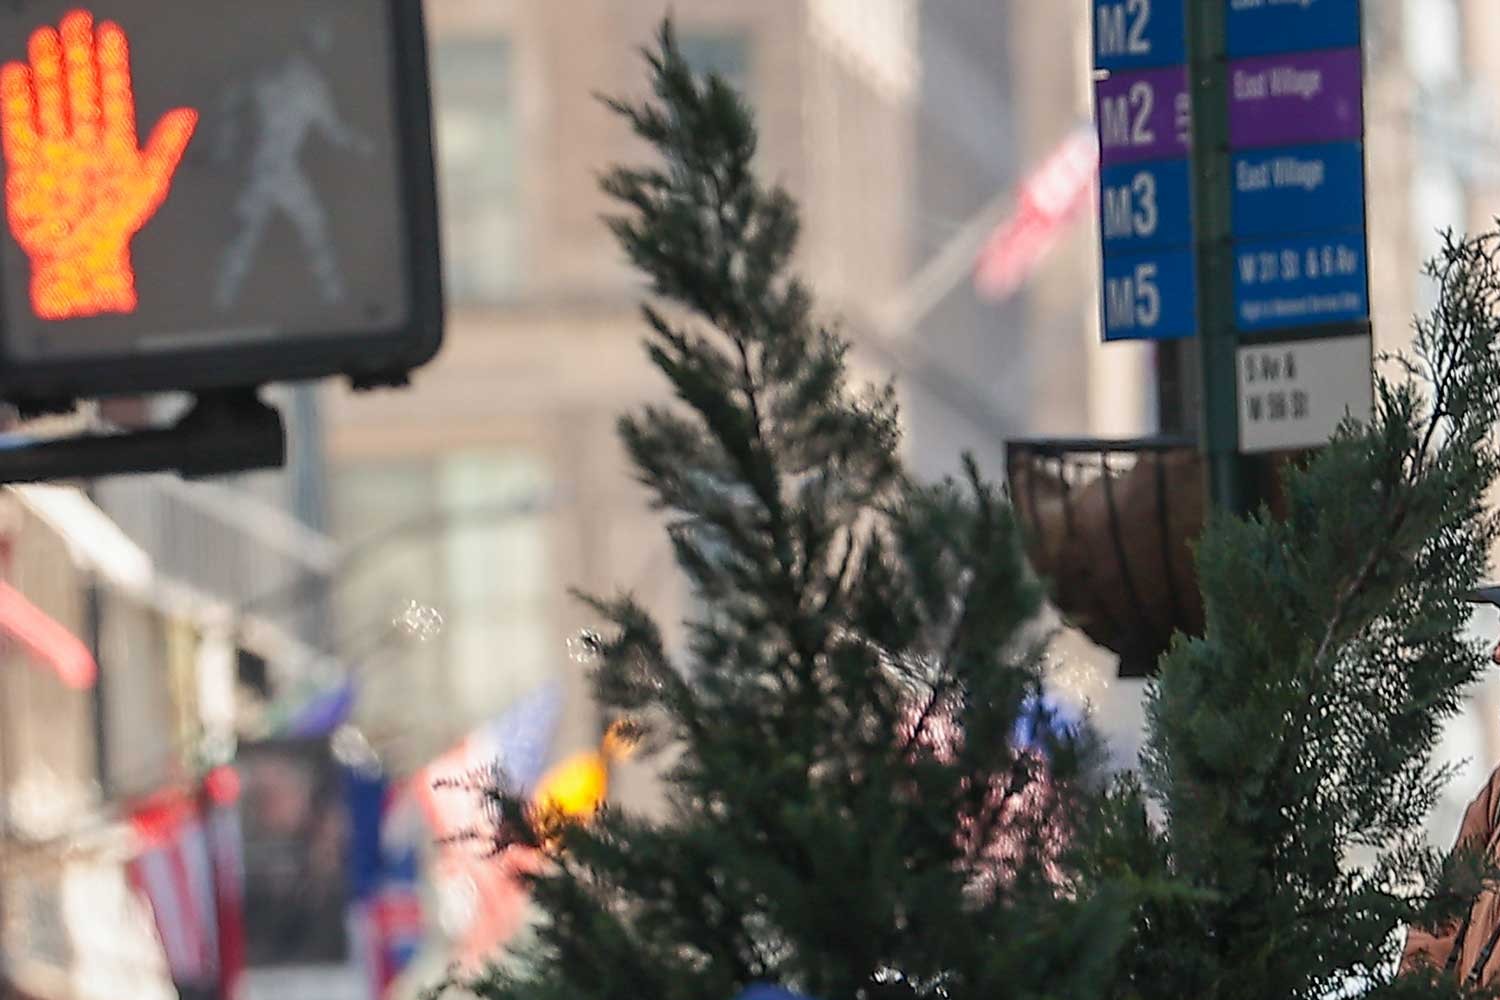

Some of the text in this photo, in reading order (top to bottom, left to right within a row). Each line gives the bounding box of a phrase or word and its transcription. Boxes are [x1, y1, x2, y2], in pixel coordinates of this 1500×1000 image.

[1098, 0, 1151, 55] M2
[1233, 66, 1321, 99] East Village
[1101, 80, 1155, 147] M2
[1236, 157, 1324, 190] East Village
[1104, 170, 1158, 239] M3
[1107, 263, 1160, 331] M5
